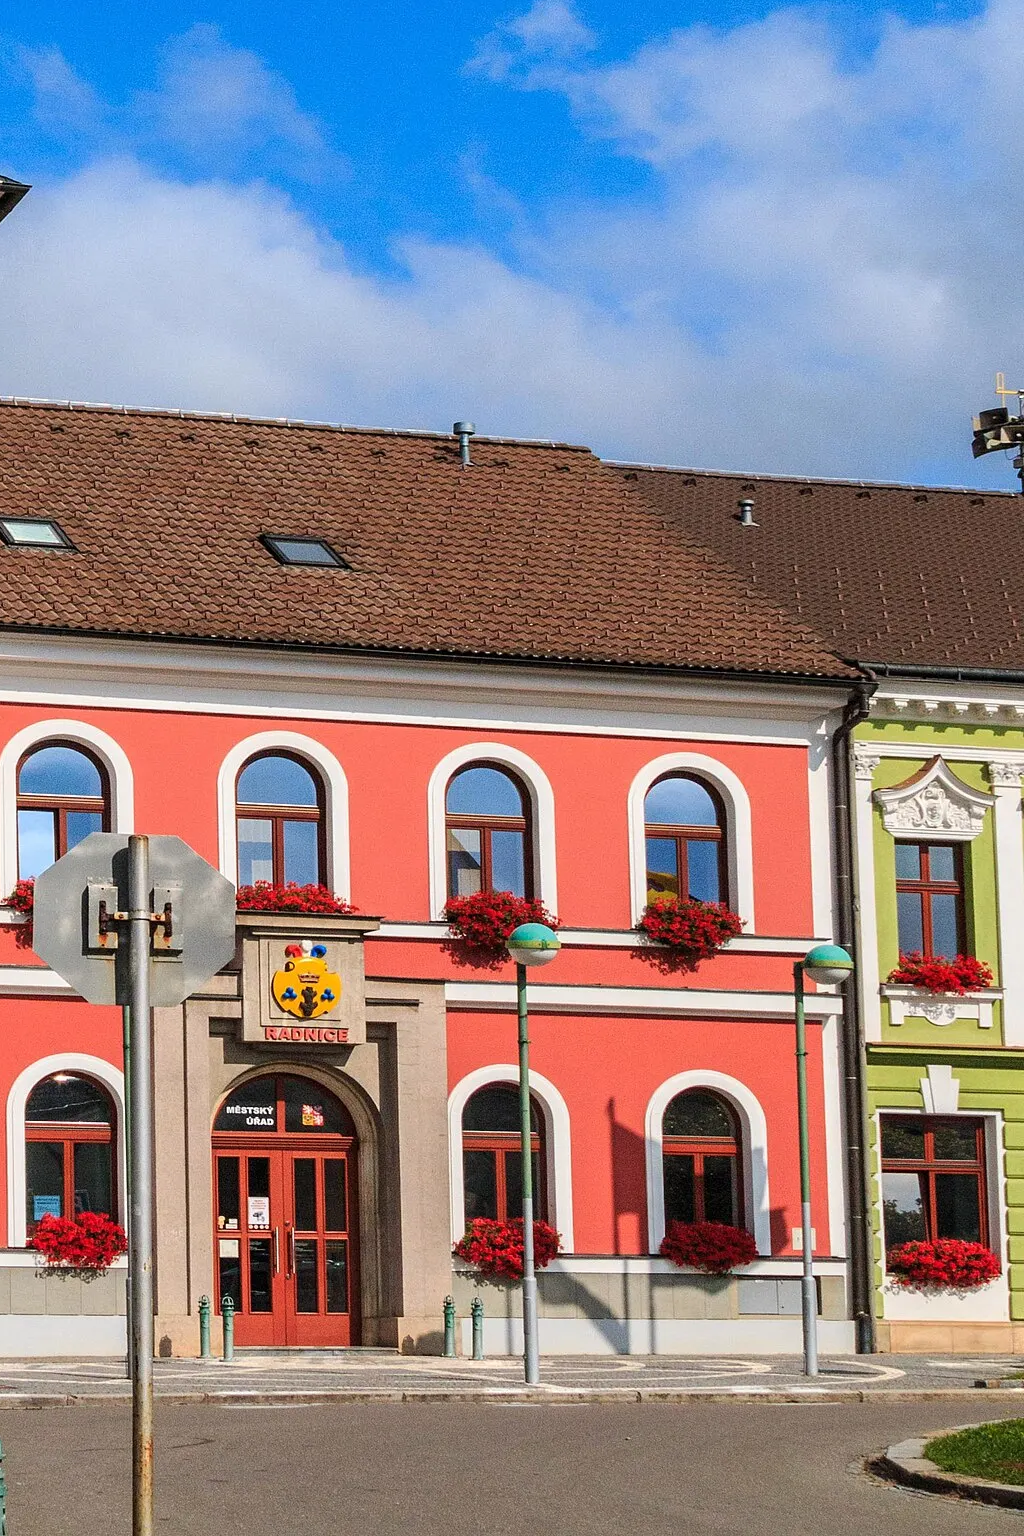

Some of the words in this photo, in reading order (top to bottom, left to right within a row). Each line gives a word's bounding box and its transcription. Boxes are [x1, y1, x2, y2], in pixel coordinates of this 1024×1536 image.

[265, 1027, 349, 1043] RADNICE
[226, 1105, 274, 1115] MĚSTSKÝ
[246, 1116, 274, 1126] ÚŘAD
